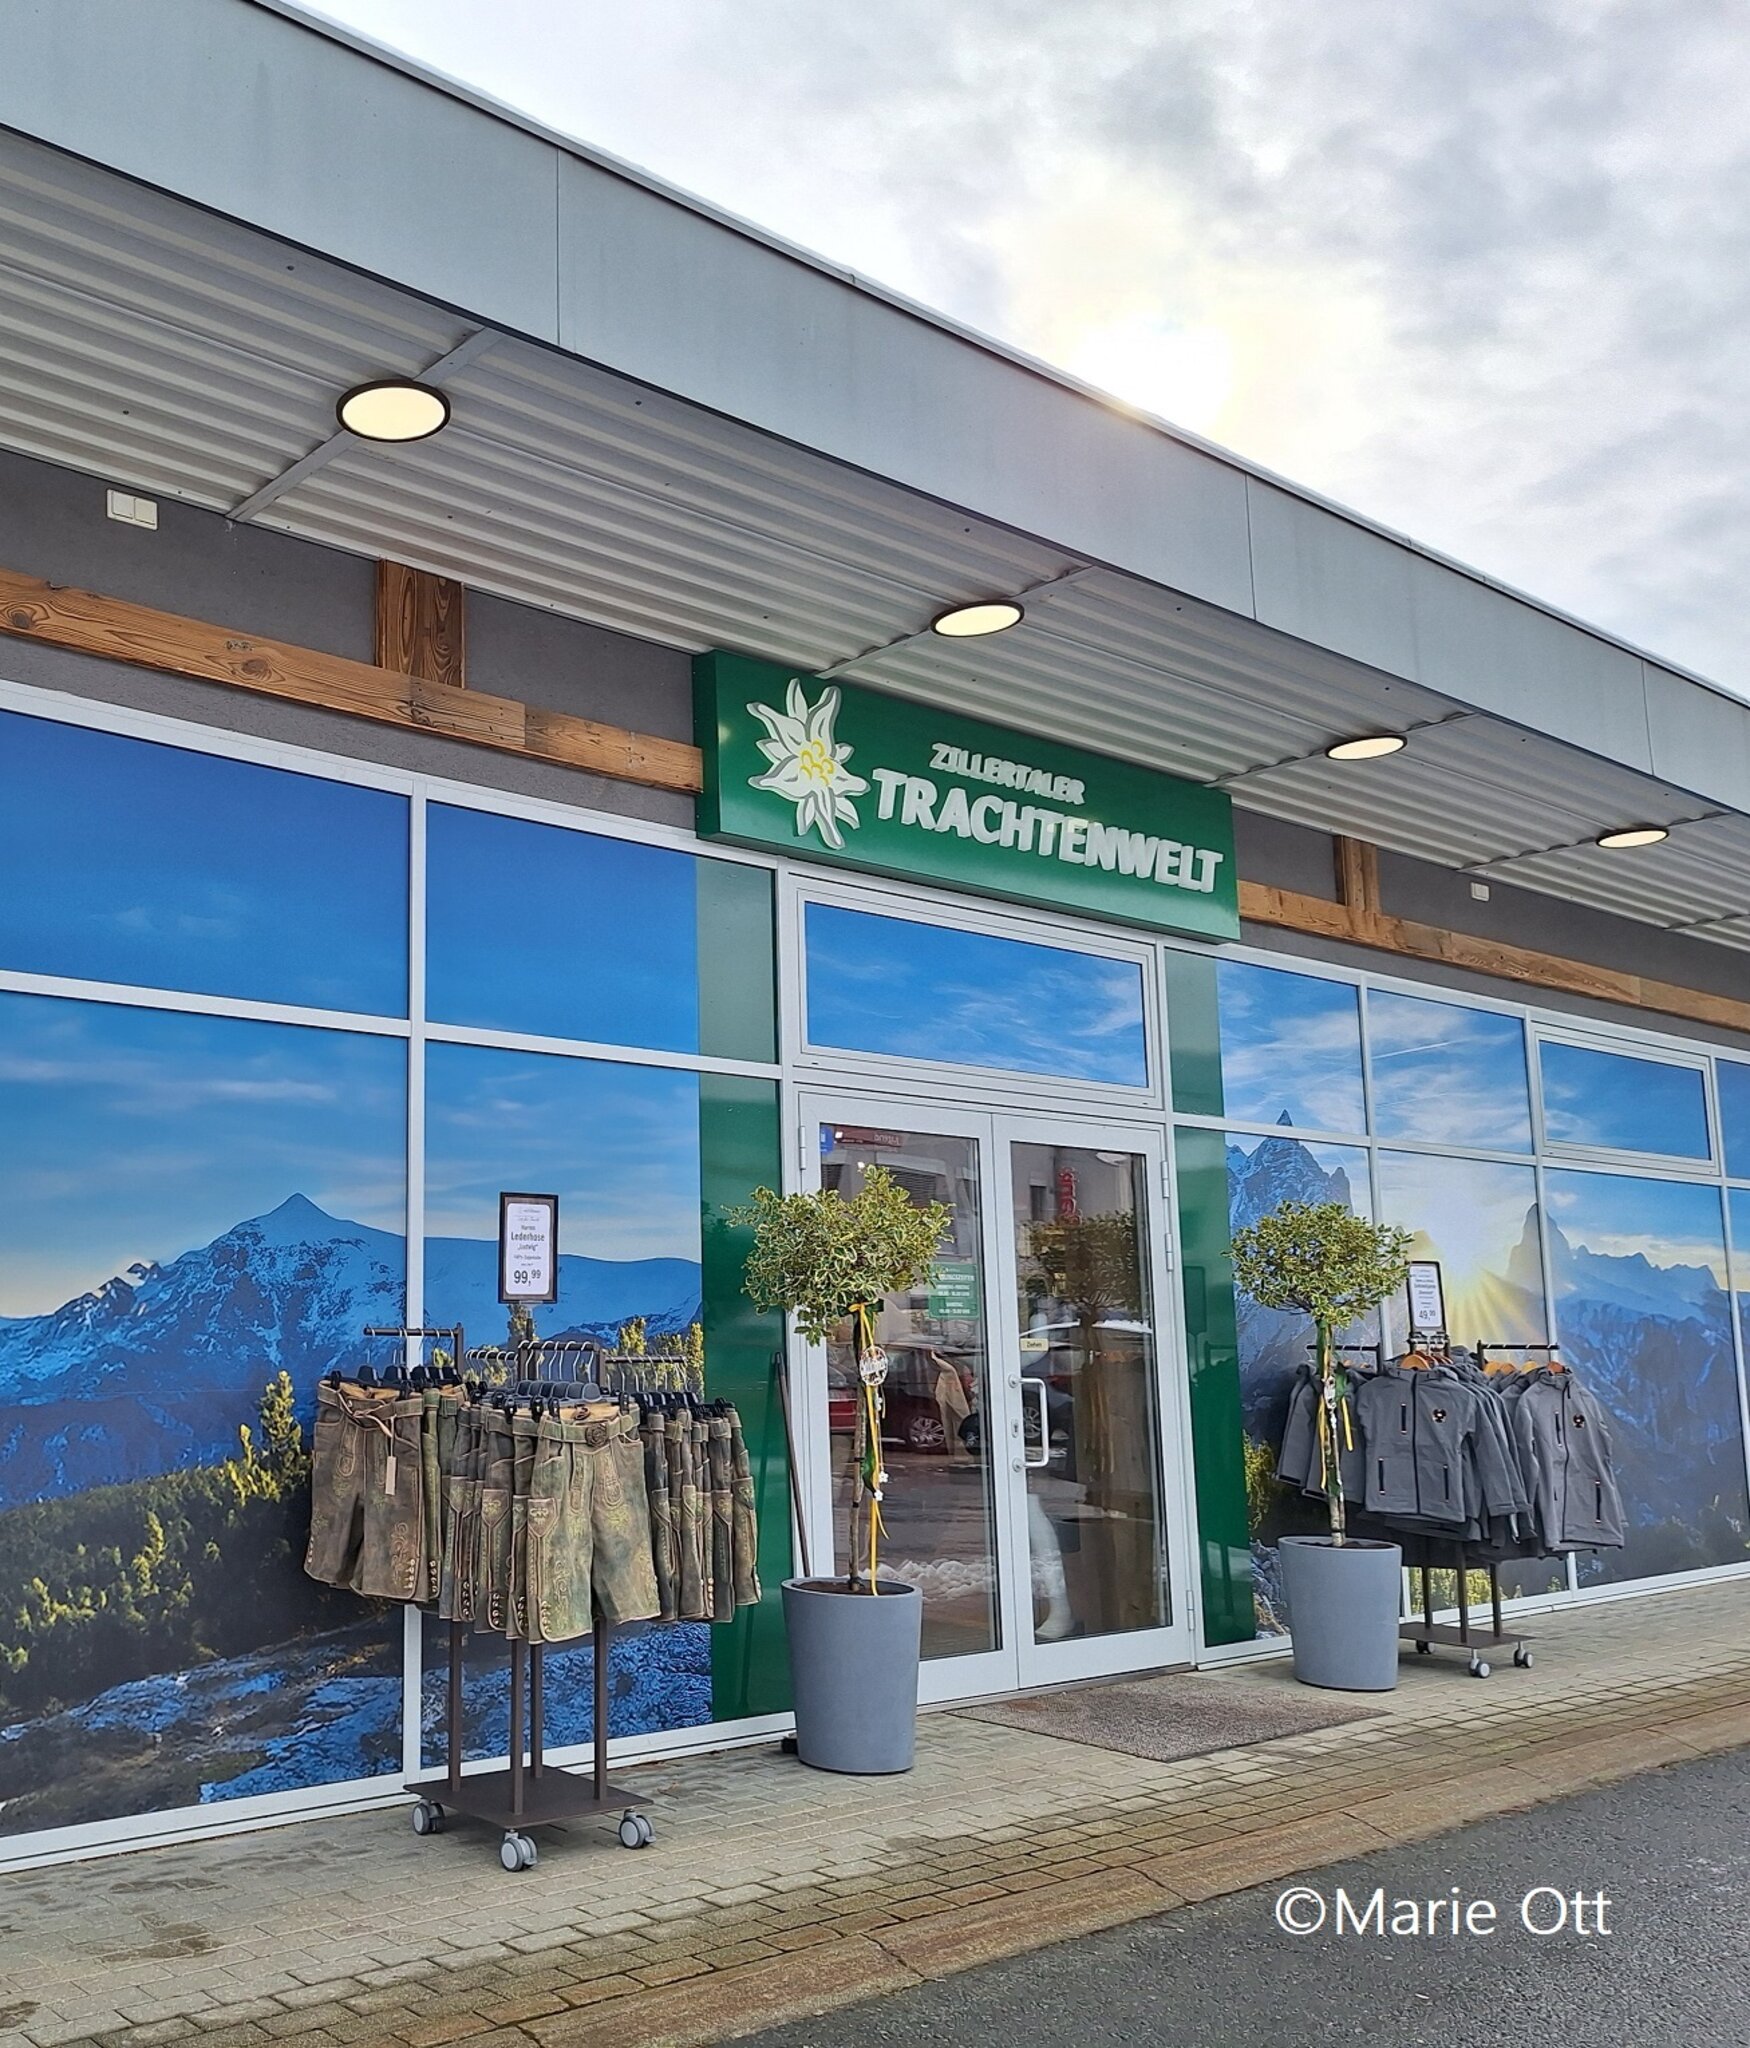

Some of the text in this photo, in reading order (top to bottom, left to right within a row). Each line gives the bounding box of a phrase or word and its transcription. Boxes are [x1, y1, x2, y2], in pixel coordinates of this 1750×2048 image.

[929, 743, 1085, 805] ZILLERTALER
[873, 768, 1223, 893] TRACHTENWELT
[511, 1231, 545, 1242] Lederhose
